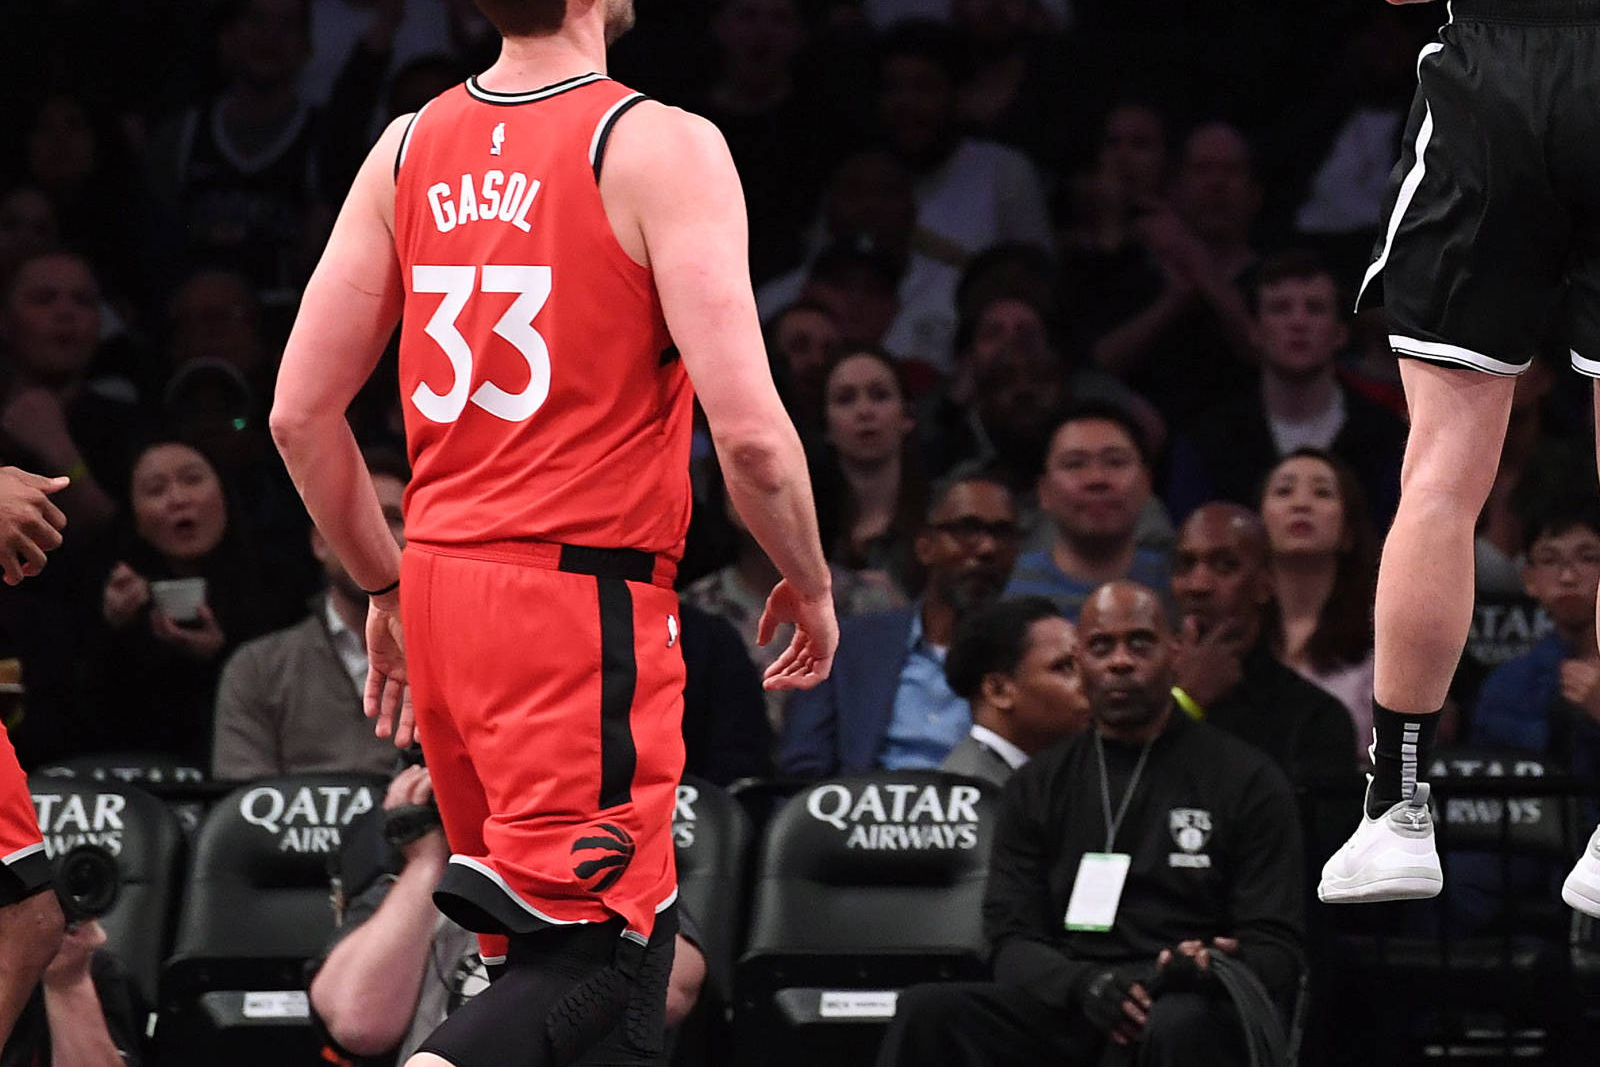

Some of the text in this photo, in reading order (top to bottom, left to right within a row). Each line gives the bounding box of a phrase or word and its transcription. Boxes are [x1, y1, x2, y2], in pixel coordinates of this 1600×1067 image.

[427, 170, 541, 233] GASOL
[411, 264, 552, 423] 33
[31, 793, 127, 833] TAR
[240, 786, 374, 834] QATA
[806, 783, 982, 831] QATAR
[846, 823, 978, 851] AIRWAYS
